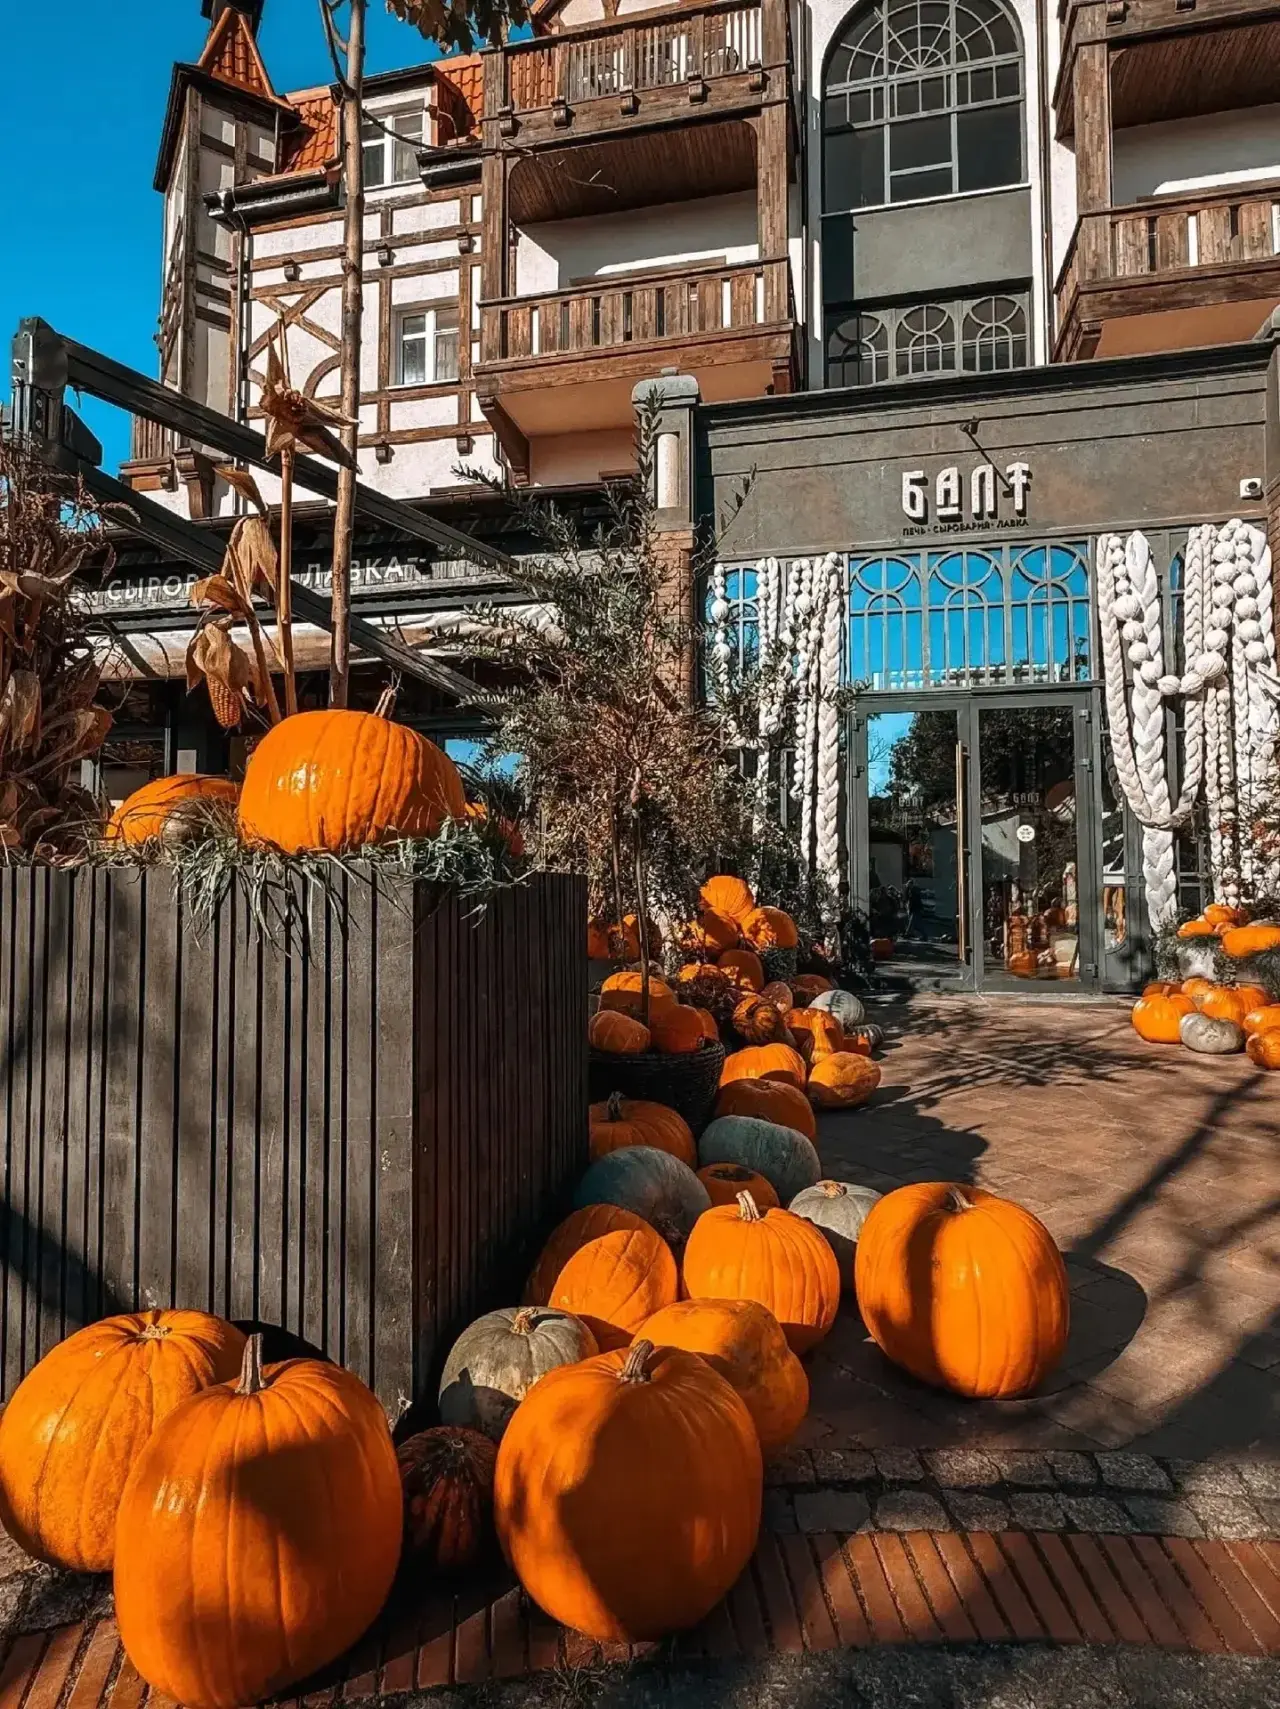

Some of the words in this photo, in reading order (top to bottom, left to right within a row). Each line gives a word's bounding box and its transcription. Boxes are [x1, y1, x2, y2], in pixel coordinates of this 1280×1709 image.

[902, 462, 1030, 519] БАЛТ
[996, 518, 1029, 530] ЛАВКА
[302, 556, 404, 585] ЛВКА
